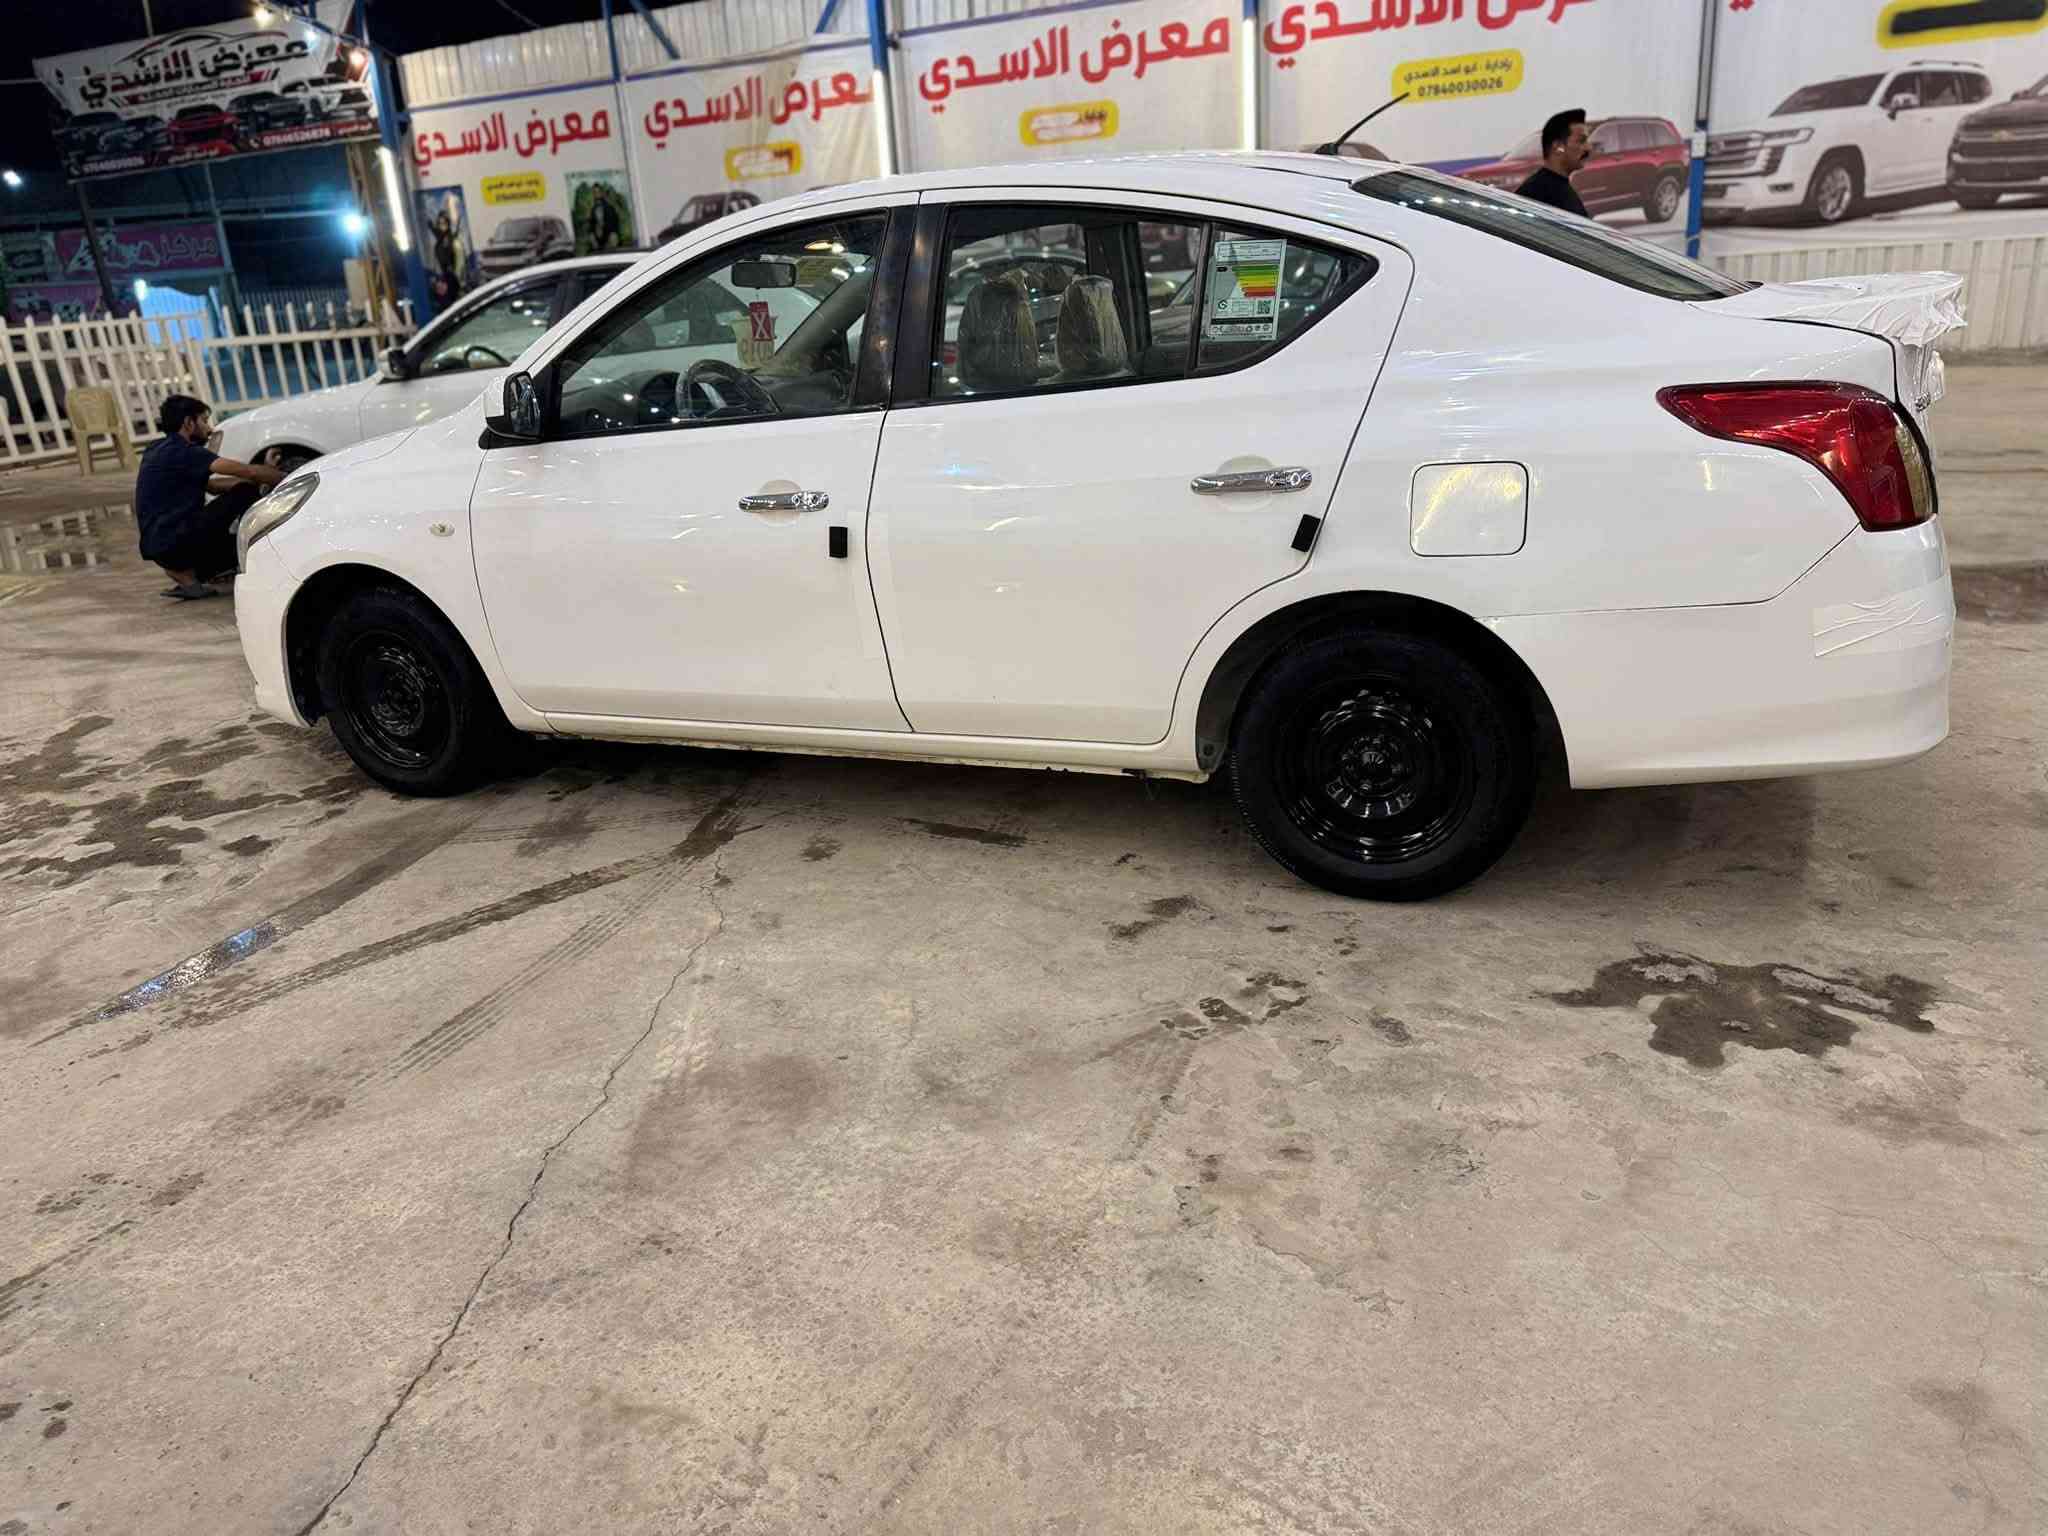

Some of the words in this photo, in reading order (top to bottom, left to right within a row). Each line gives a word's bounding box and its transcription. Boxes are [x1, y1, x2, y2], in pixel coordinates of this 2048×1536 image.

[200, 41, 309, 77] معرض
[918, 25, 1069, 113] الاسدي
[1080, 17, 1230, 83] معرض
[644, 75, 762, 149] الاسدي
[769, 70, 874, 125] عرض
[412, 112, 508, 176] الاسدي
[514, 109, 611, 157] معرض
